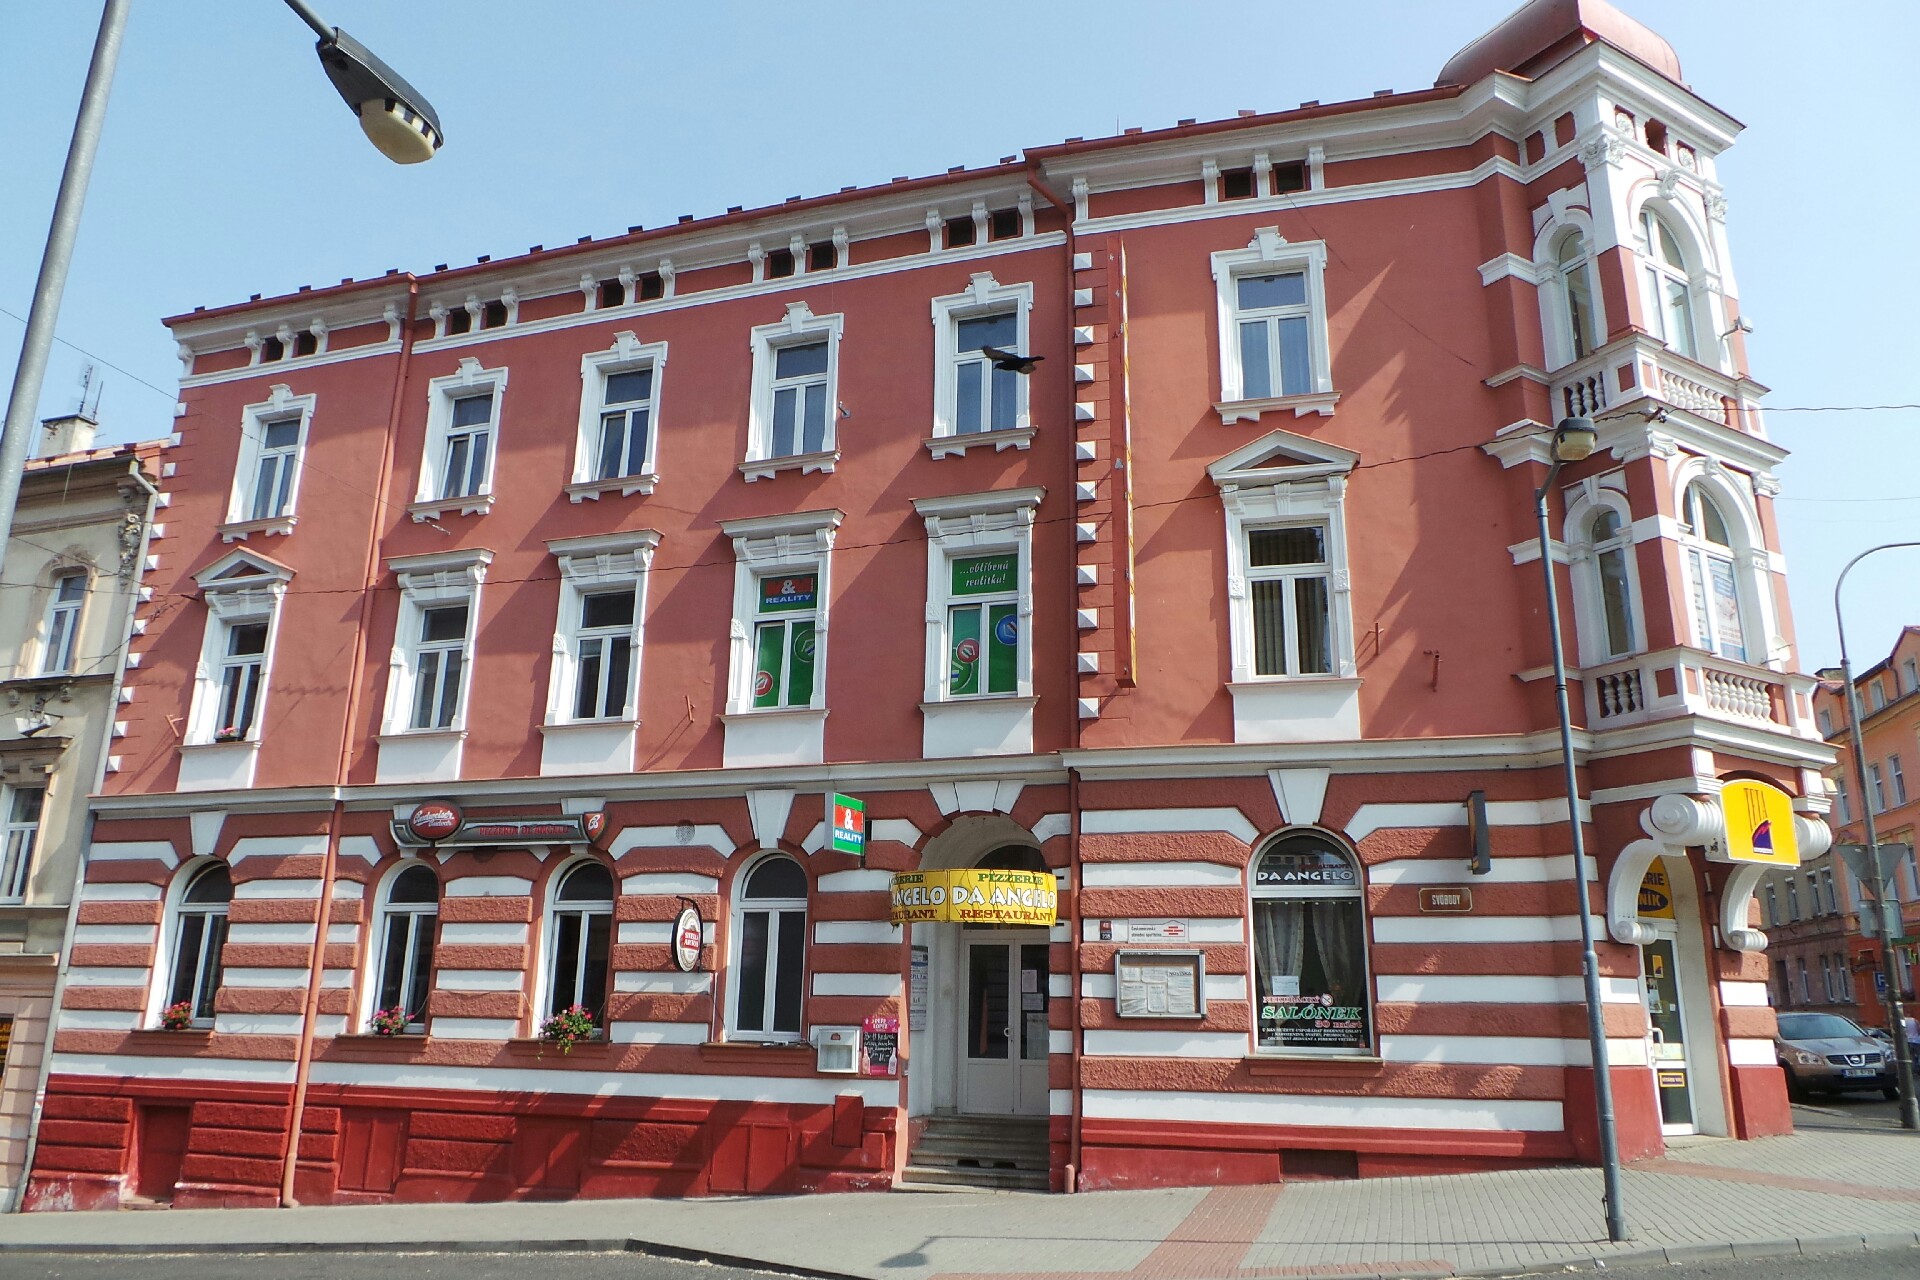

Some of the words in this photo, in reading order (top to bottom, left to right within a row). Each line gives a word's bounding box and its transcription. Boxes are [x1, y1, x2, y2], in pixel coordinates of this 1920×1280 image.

[765, 594, 811, 604] REALITY
[1743, 787, 1769, 833] TETA
[834, 829, 862, 844] REALITY
[893, 874, 923, 885] ERIE
[978, 873, 1043, 885] PIZZERIE
[1258, 871, 1281, 881] DA
[1284, 870, 1354, 881] ANGELO
[952, 886, 986, 906] DA
[989, 886, 1056, 909] ANGELO
[1431, 894, 1461, 905] SVOBODY
[893, 909, 937, 920] AURANT
[960, 909, 1052, 922] RESTAURANT
[1262, 1004, 1362, 1020] SALÓNEK
